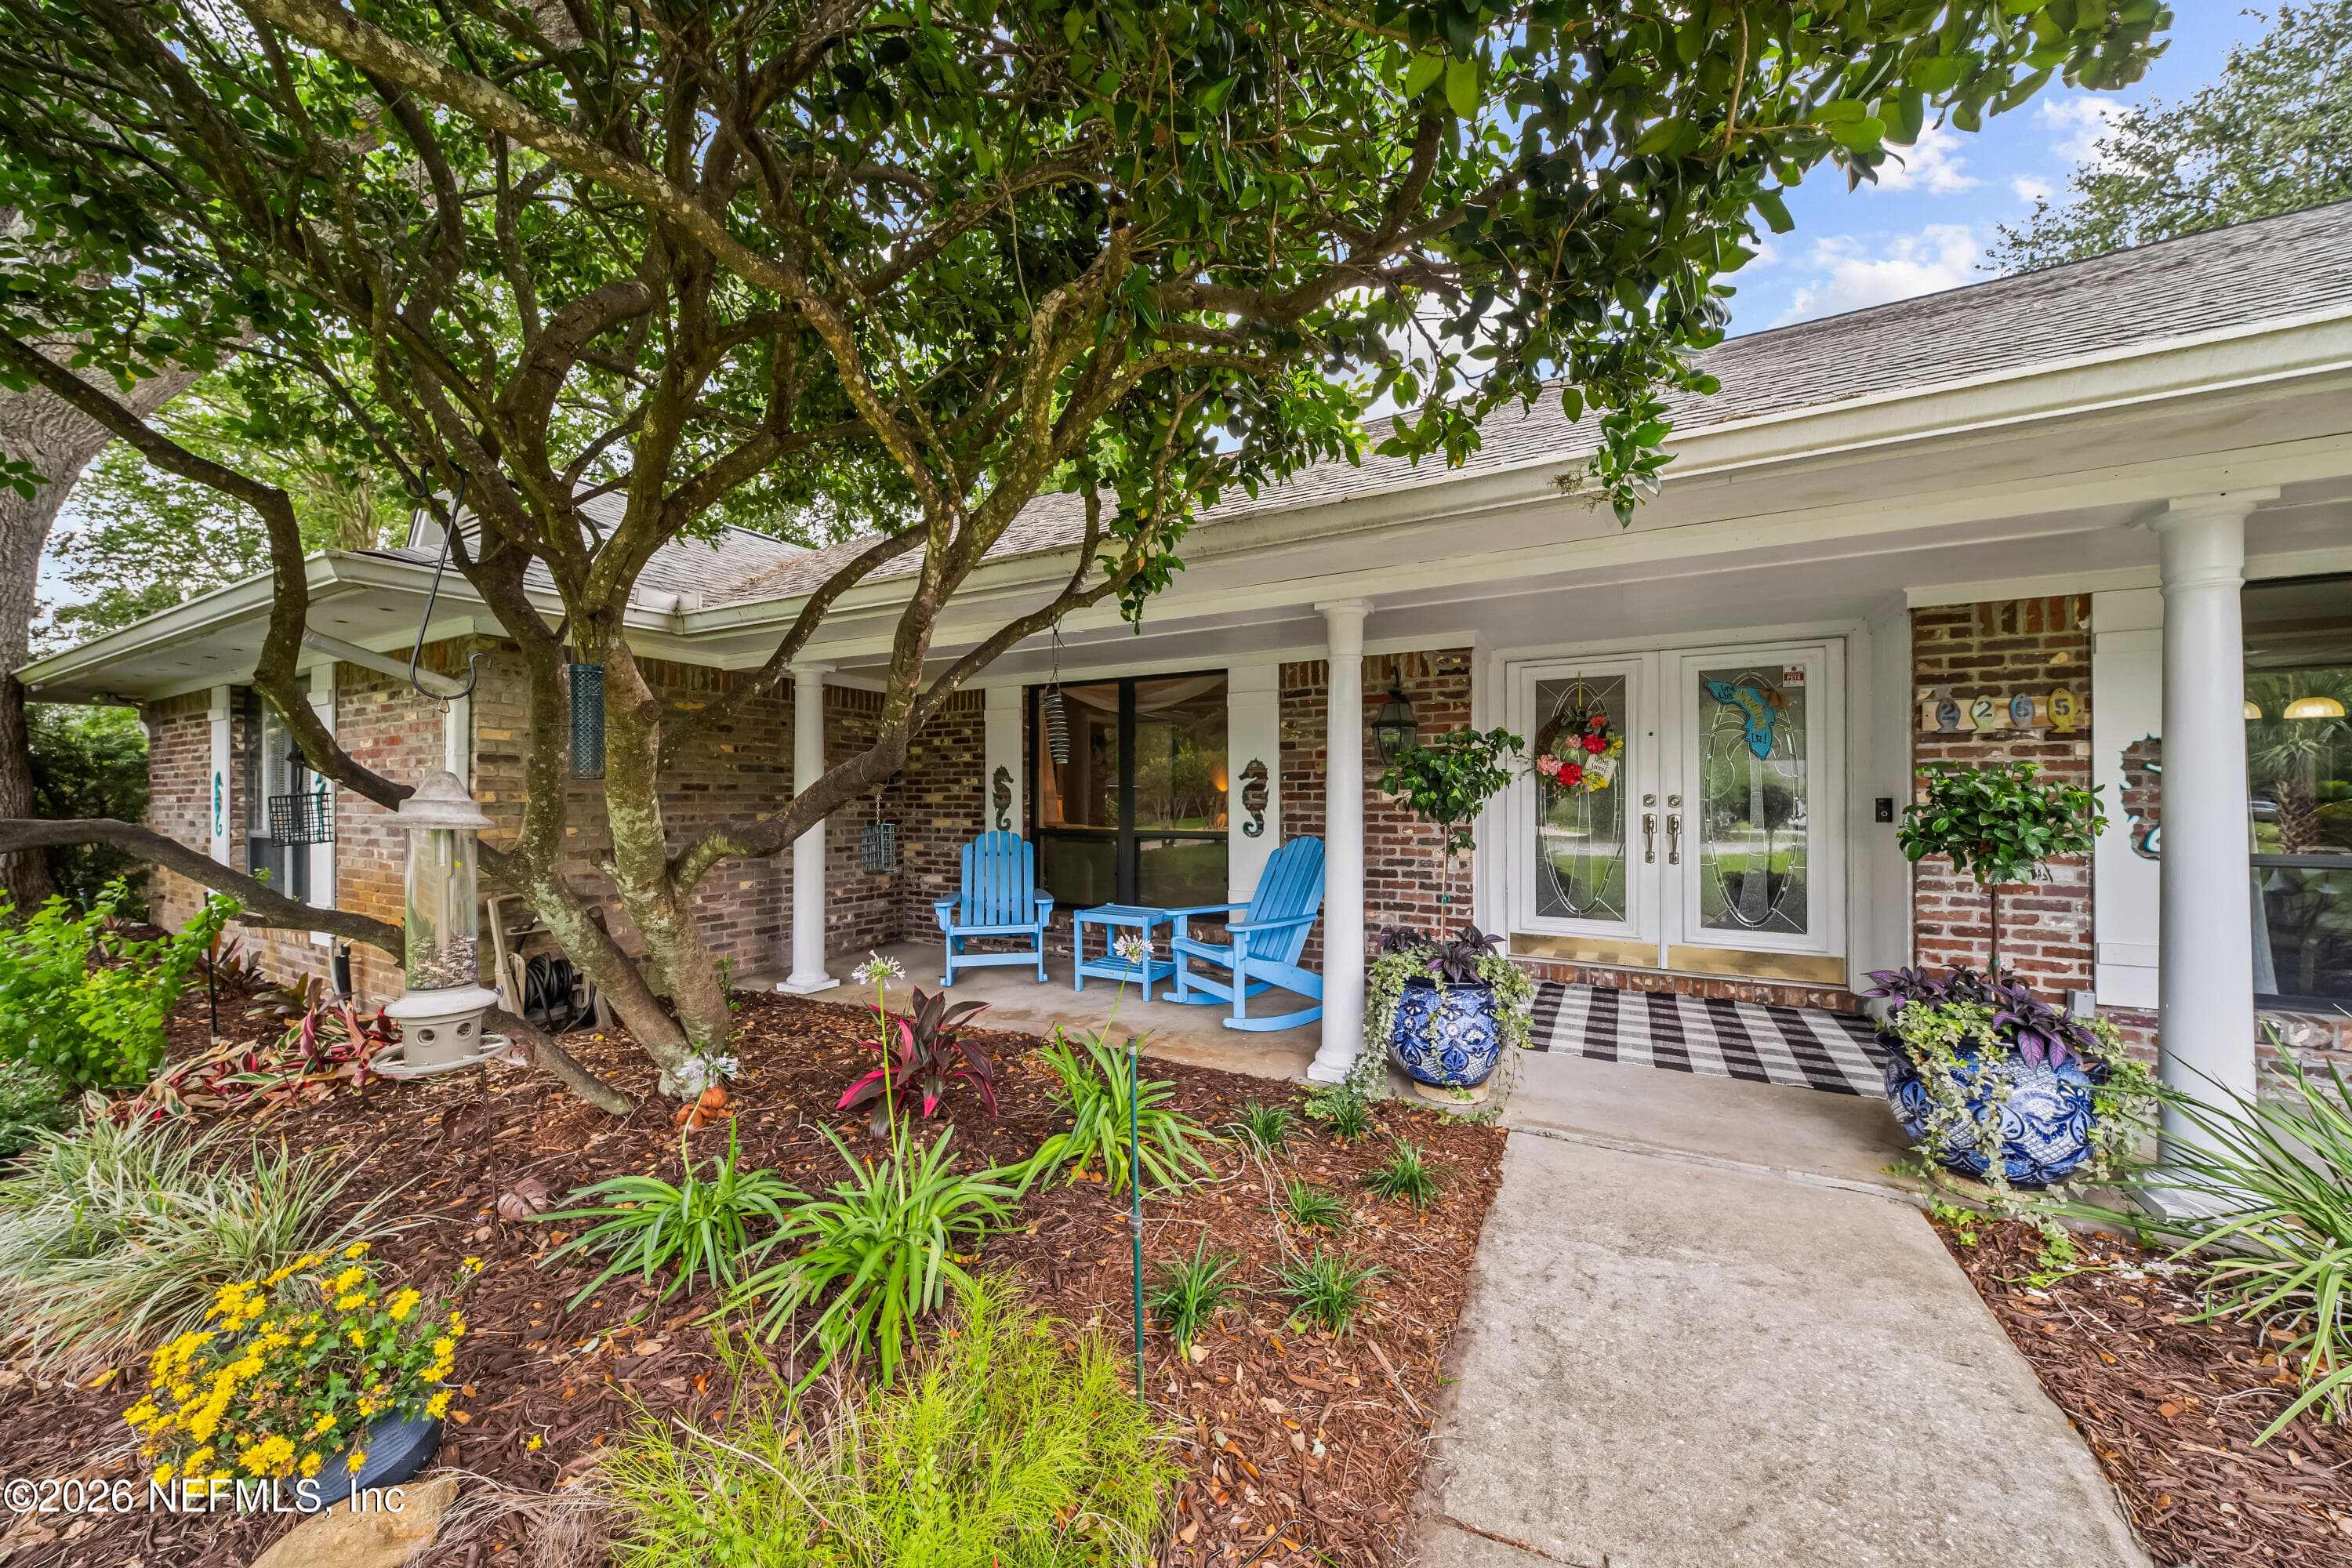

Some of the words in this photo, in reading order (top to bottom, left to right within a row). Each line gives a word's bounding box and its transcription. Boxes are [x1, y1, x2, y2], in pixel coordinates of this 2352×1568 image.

[1941, 698, 2071, 720] 2265
[1751, 733, 1767, 744] in!
[1594, 757, 1610, 767] HOME
